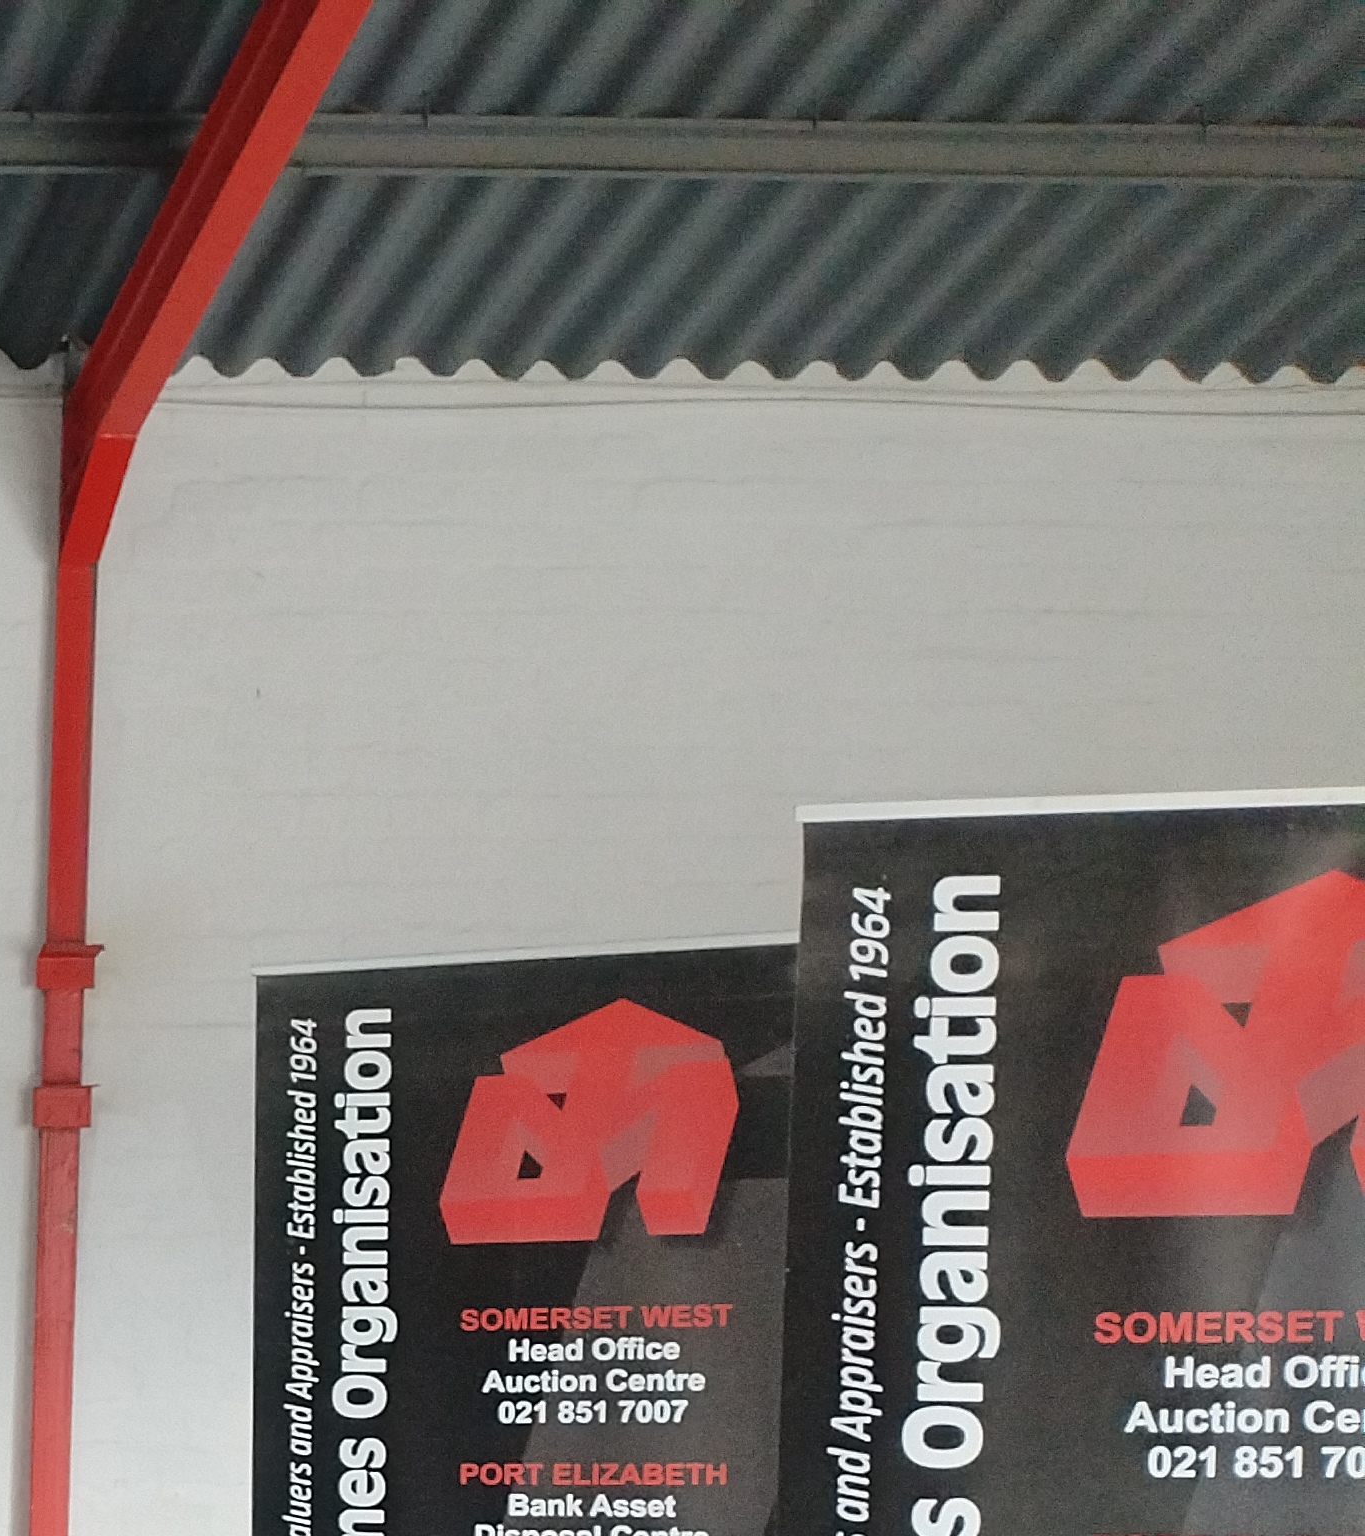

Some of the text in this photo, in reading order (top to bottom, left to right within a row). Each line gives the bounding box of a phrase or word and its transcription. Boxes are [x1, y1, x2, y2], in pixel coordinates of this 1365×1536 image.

[849, 886, 892, 982] 1964
[291, 1017, 318, 1083] 1964
[837, 990, 888, 1210] Established
[285, 1090, 317, 1240] Established
[901, 875, 1002, 1469] Organisation
[332, 1008, 398, 1419] Organisation
[284, 1261, 318, 1401] Appraisers
[461, 1303, 733, 1333] SOMERSET WEST
[1094, 1311, 1343, 1344] SOMERSET
[509, 1336, 681, 1363] Head Office
[831, 1240, 883, 1443] Appraisers
[482, 1368, 706, 1394] Auction Centre
[1164, 1356, 1365, 1389] Head Offi
[284, 1406, 314, 1458] and
[498, 1399, 690, 1424] 021 851 7007
[1124, 1401, 1290, 1434] Auction
[459, 1463, 728, 1486] PORT ELIZABETH
[1147, 1446, 1304, 1479] 021 851
[508, 1494, 677, 1518] Bank Asset
[828, 1450, 870, 1525] and
